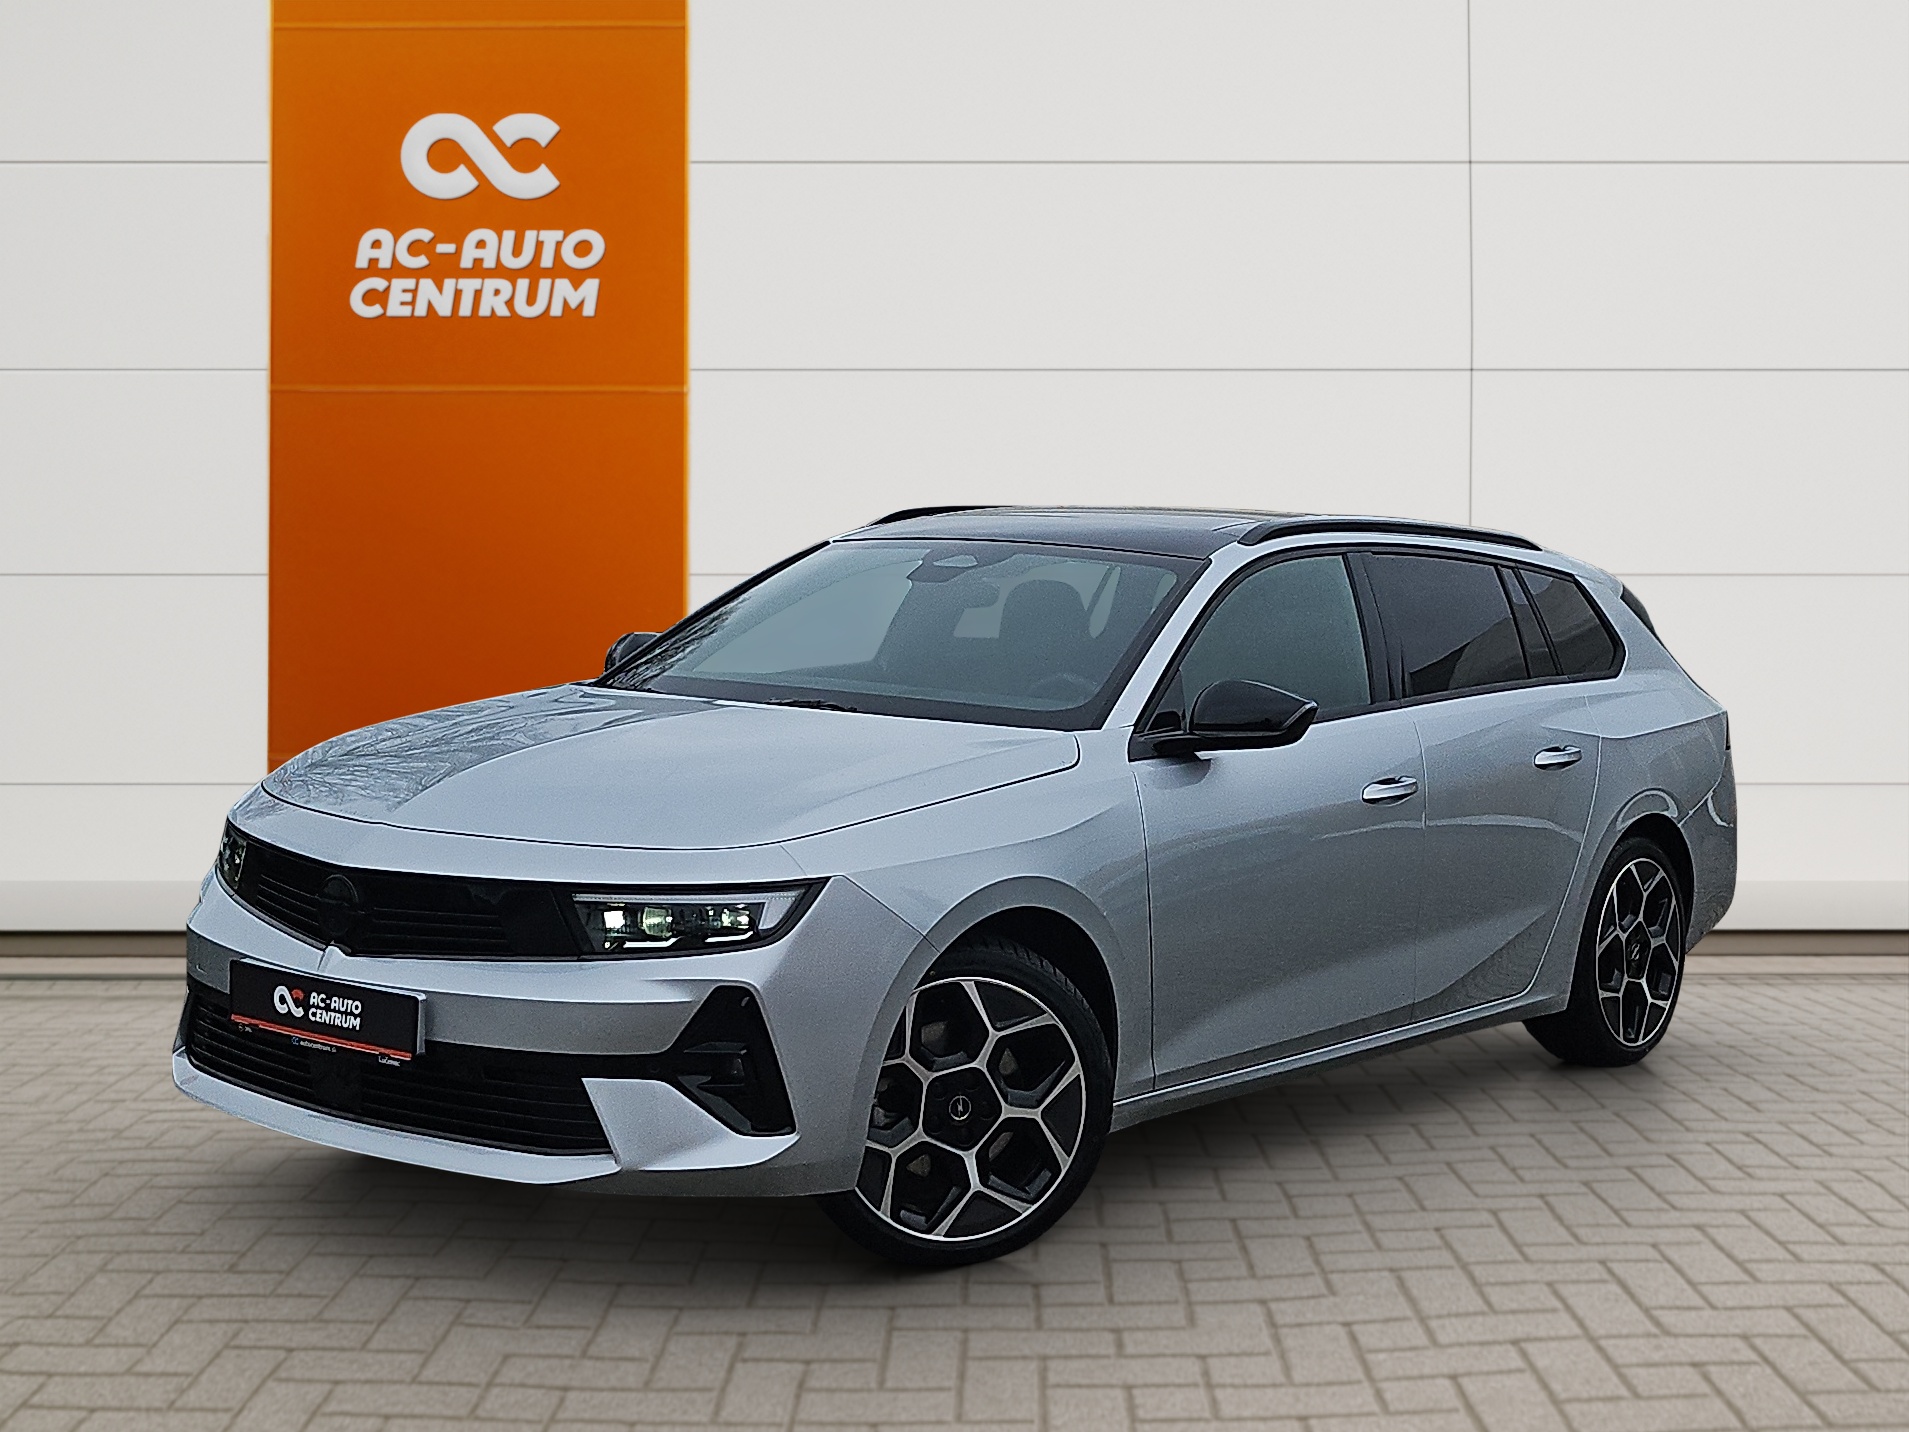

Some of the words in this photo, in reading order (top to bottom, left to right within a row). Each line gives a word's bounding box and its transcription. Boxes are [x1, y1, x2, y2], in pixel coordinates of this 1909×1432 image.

[355, 228, 606, 270] AC-AUTO
[350, 276, 600, 318] CENTRUM
[308, 1008, 361, 1030] CENTRUM
[309, 992, 362, 1015] AC-AUTO
